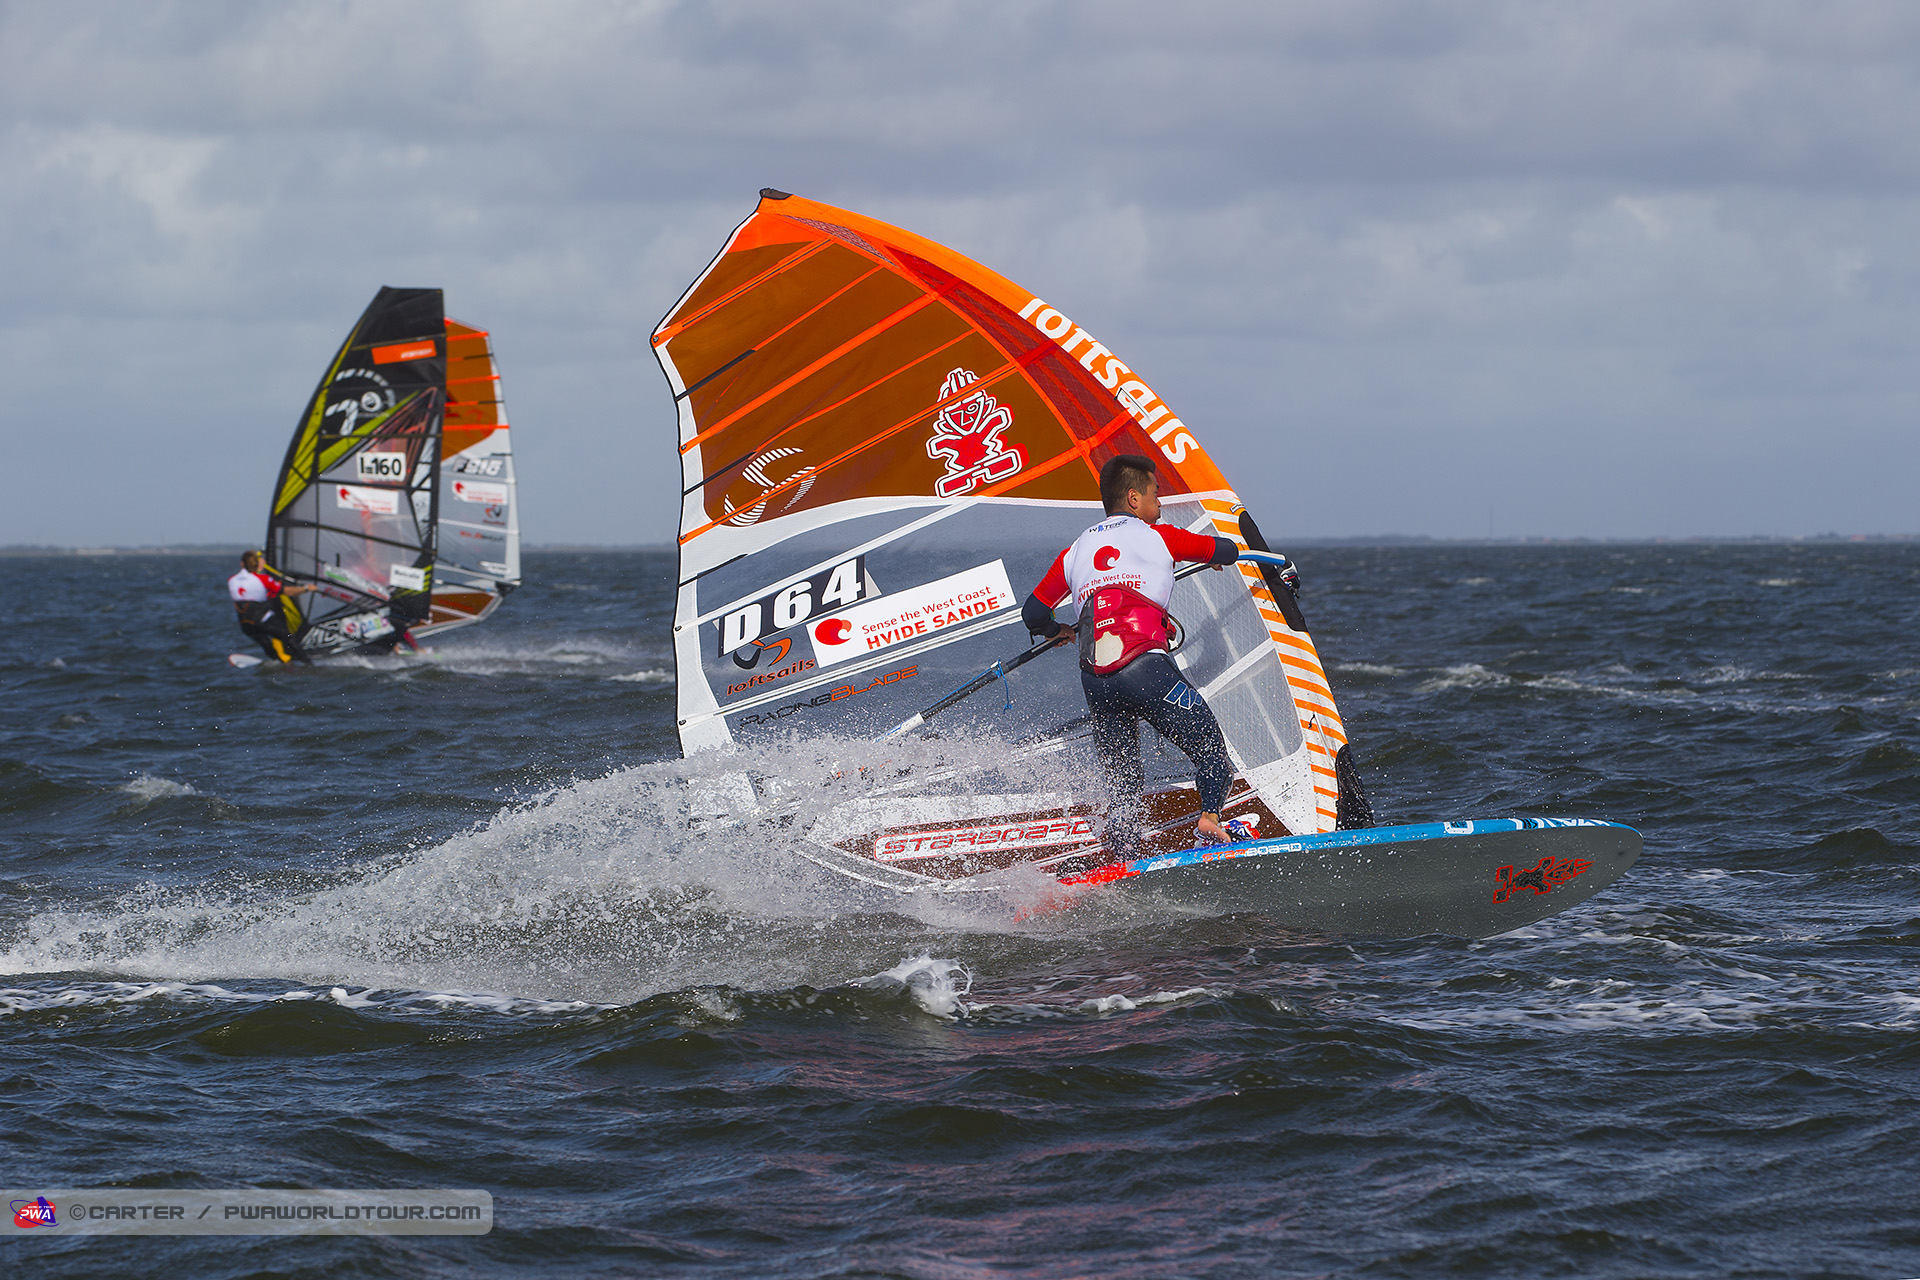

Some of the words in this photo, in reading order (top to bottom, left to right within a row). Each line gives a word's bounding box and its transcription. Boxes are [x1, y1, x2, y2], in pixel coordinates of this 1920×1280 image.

[1091, 578, 1102, 586] the
[1102, 574, 1120, 583] West
[1122, 572, 1142, 580] Coast
[862, 616, 898, 635] Sense
[900, 609, 921, 623] the
[922, 598, 956, 615] West
[957, 586, 992, 604] Coast
[866, 620, 928, 650] HVIDE
[932, 596, 1001, 629] SANDE
[727, 658, 816, 696] loftsails
